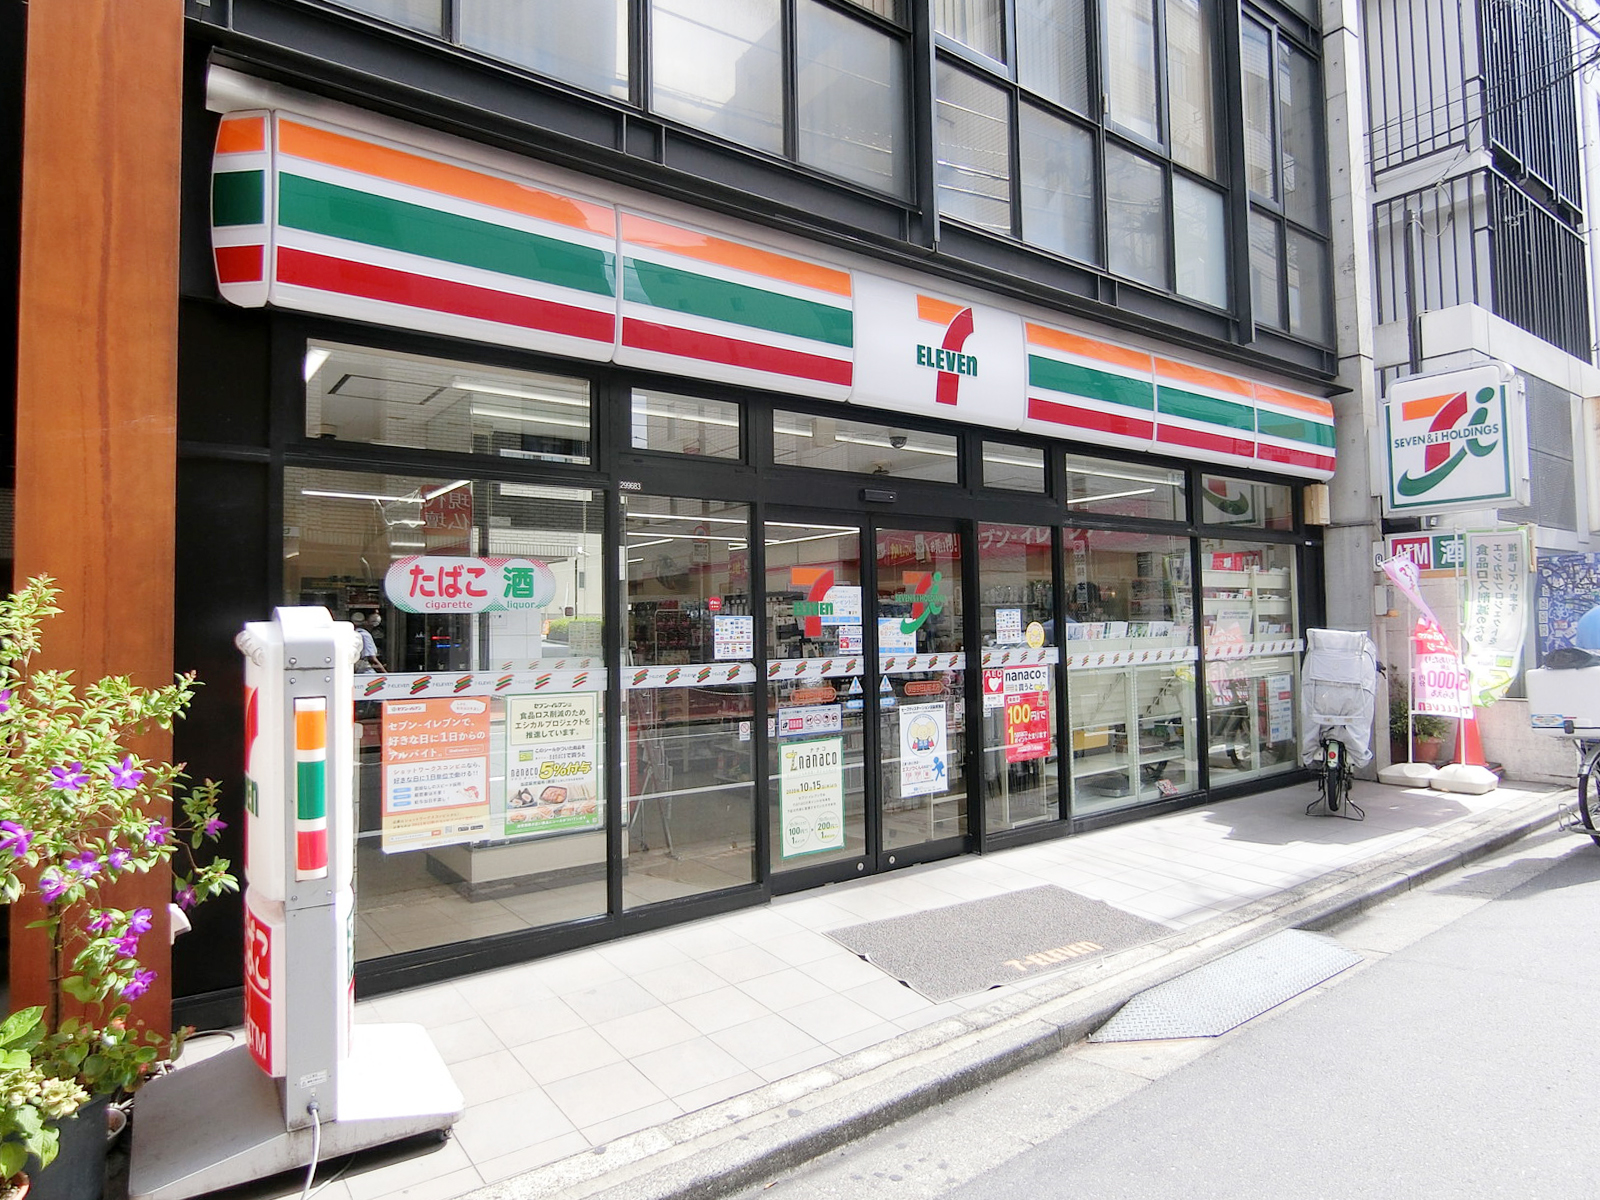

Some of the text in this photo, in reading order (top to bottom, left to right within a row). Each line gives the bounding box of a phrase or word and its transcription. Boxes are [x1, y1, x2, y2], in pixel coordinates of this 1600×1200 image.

[1441, 423, 1499, 441] HOLDINGS
[409, 564, 535, 599] たばこ 酒
[425, 600, 536, 611] cigarette liquor
[387, 731, 486, 747] 好きな日に1日からの
[798, 751, 838, 770] nanaco
